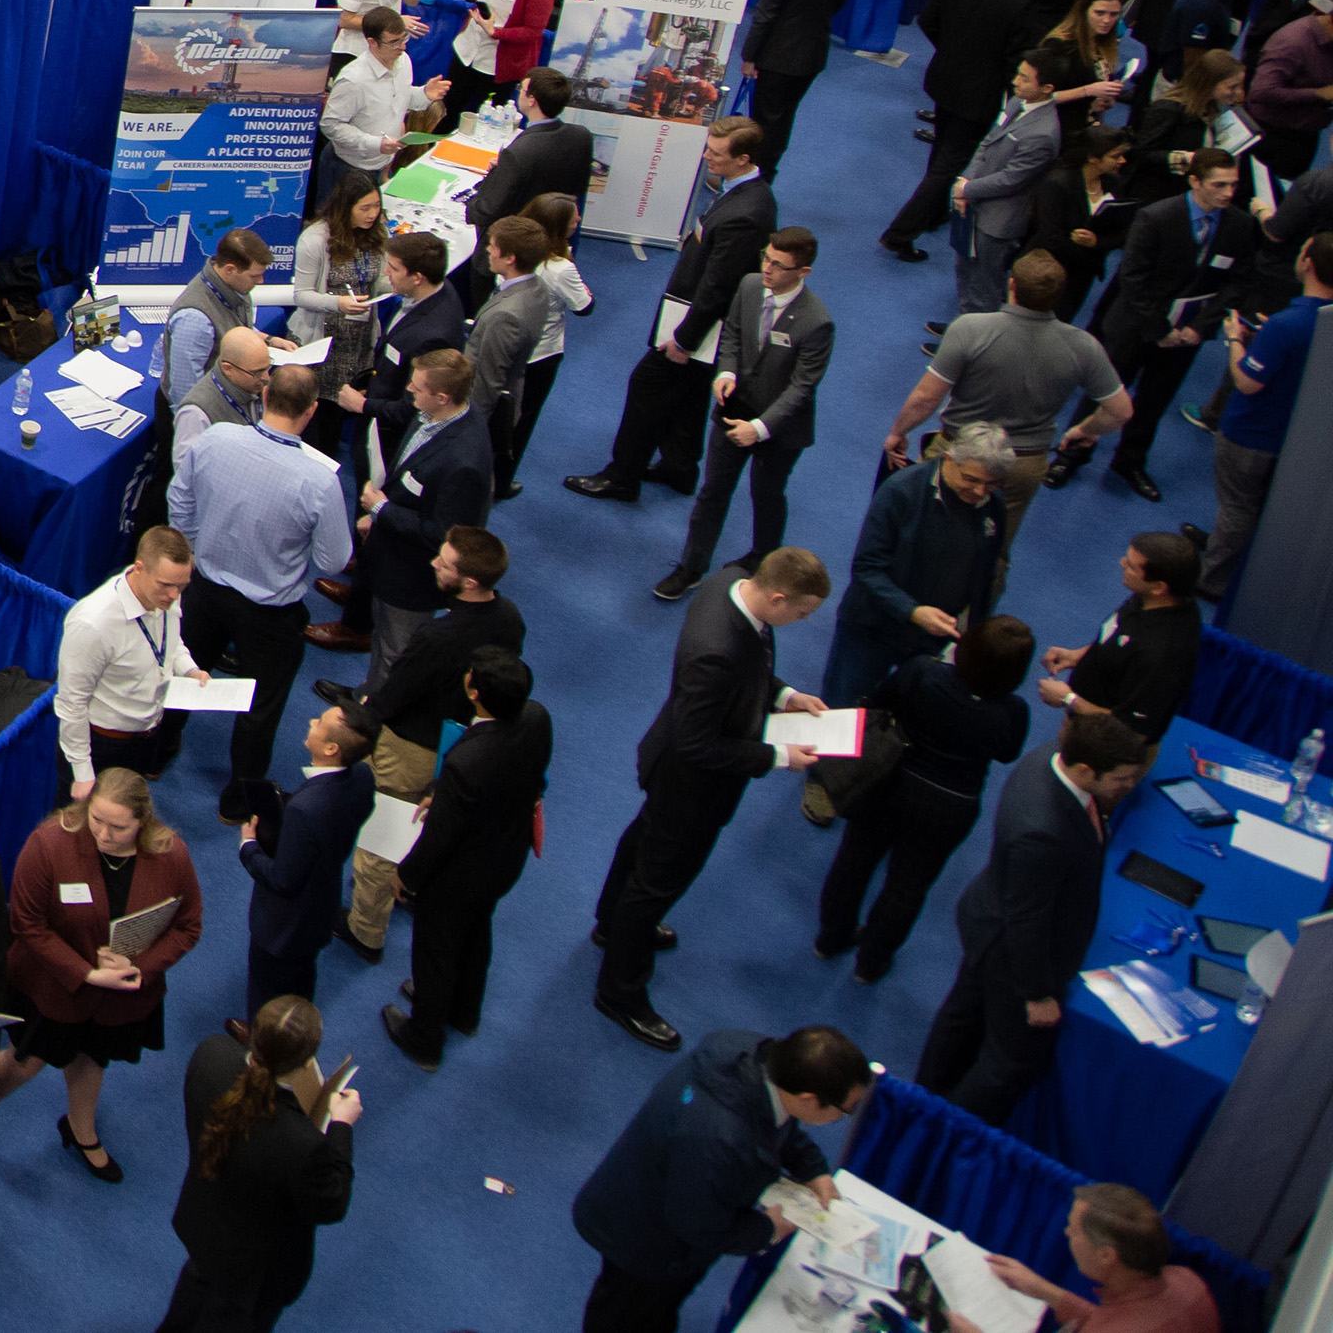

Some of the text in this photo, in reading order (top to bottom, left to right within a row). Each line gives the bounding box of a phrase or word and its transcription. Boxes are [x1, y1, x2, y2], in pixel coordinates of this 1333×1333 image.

[710, 0, 734, 11] LLC
[187, 43, 290, 60] Matador
[123, 122, 184, 132] WE ARE...
[117, 150, 165, 158] JOIN OUR
[208, 148, 311, 157] A PLACE TO GROW.
[117, 161, 145, 170] TEAM
[637, 136, 665, 218] and Exploration
